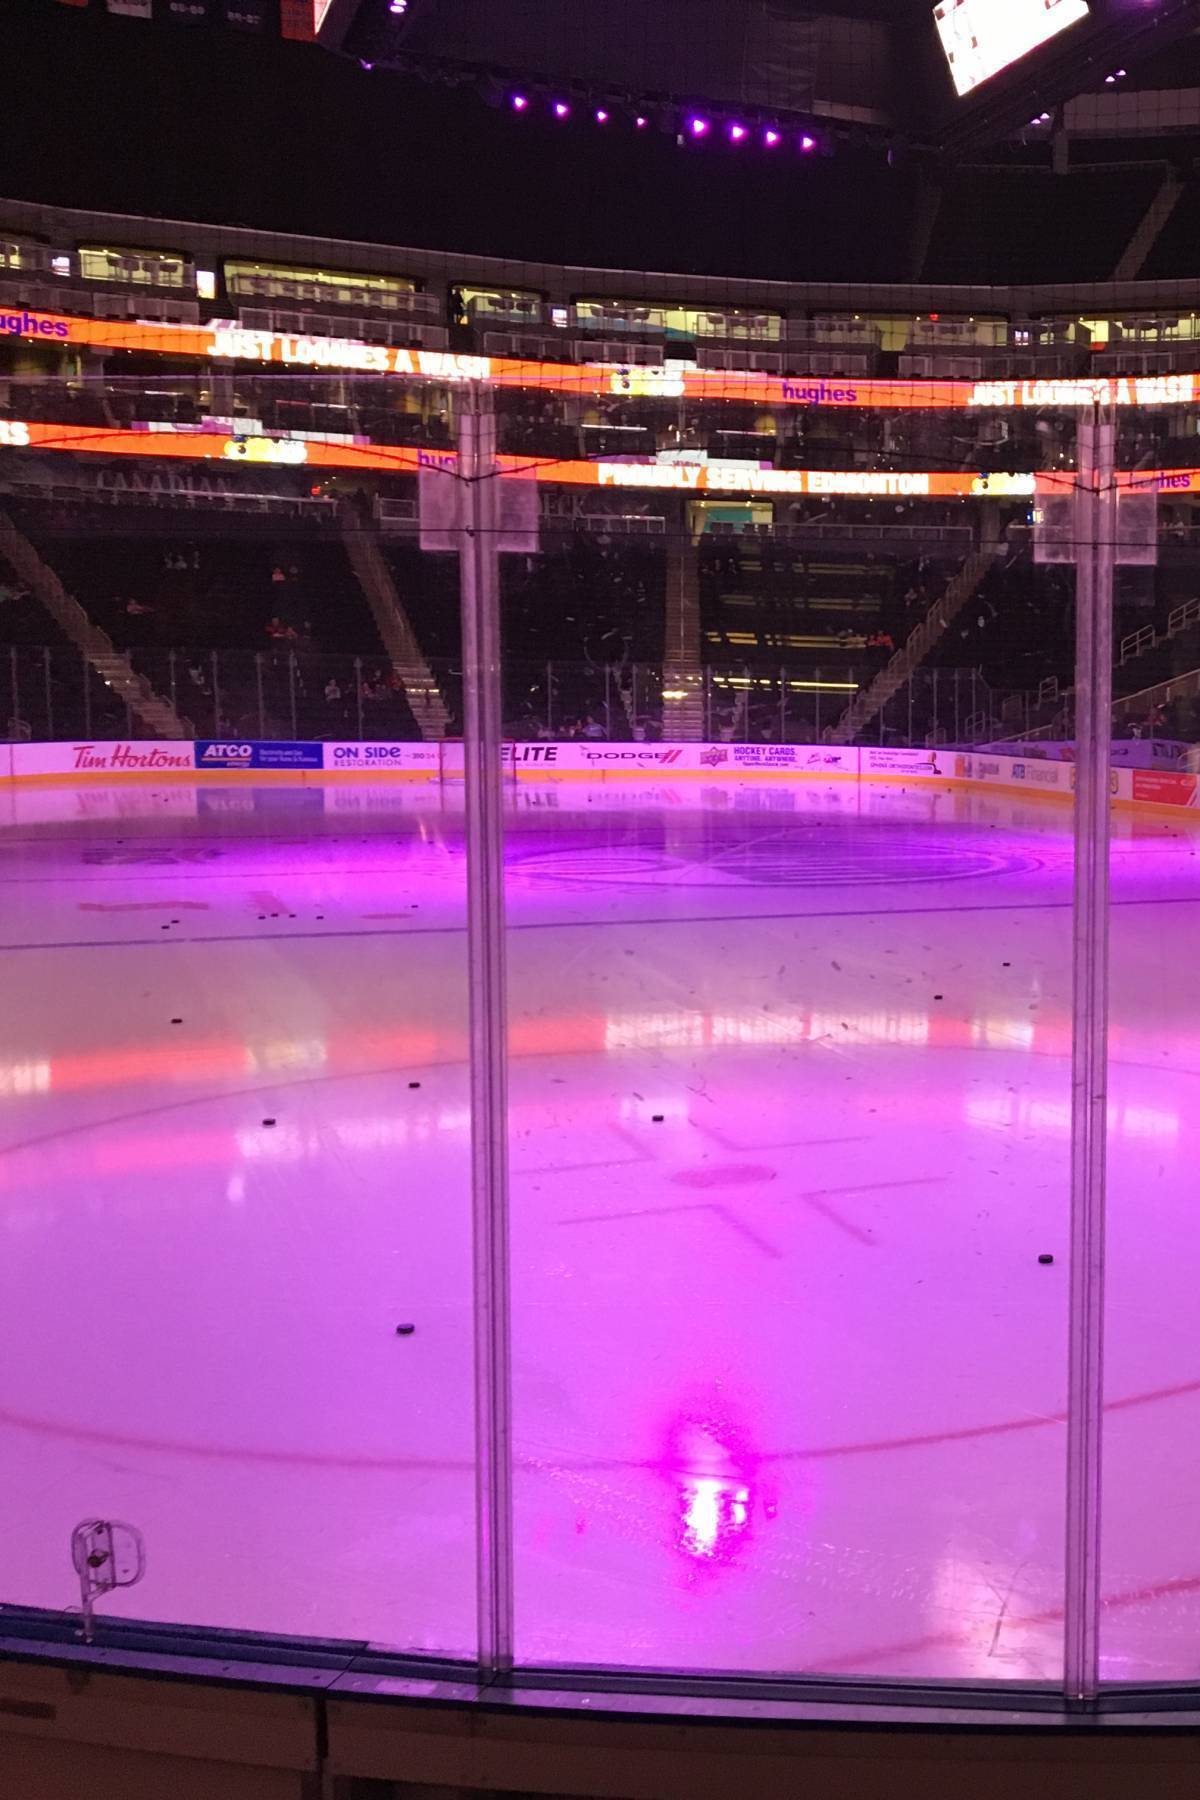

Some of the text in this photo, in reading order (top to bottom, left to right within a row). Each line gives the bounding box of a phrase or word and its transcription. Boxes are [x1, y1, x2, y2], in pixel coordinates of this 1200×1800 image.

[394, 348, 414, 373] A
[782, 380, 857, 404] hughes
[706, 467, 801, 491] SERVING
[807, 471, 929, 494] EDMONTON
[73, 744, 191, 768] Tim Hortons
[204, 744, 252, 757] ATCO
[334, 747, 354, 758] ON
[501, 746, 558, 761] ELITE
[587, 752, 666, 760] DODGE
[734, 746, 766, 755] HOCKEY
[334, 759, 402, 767] RESTORATION
